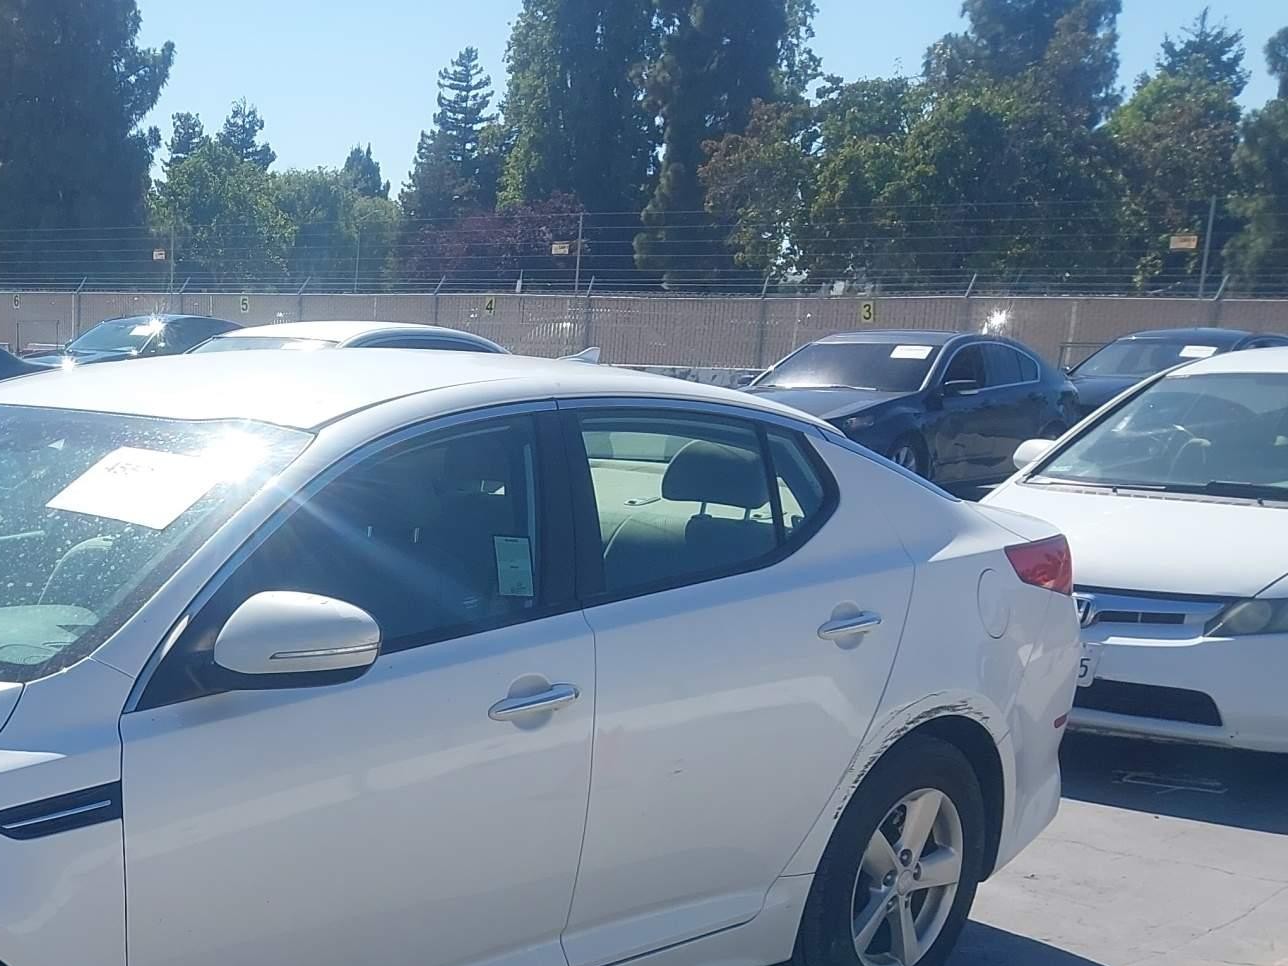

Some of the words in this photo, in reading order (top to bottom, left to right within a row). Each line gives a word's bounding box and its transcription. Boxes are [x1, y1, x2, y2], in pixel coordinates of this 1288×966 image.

[241, 298, 248, 312] 5
[485, 298, 494, 314] 4
[863, 304, 872, 320] 3
